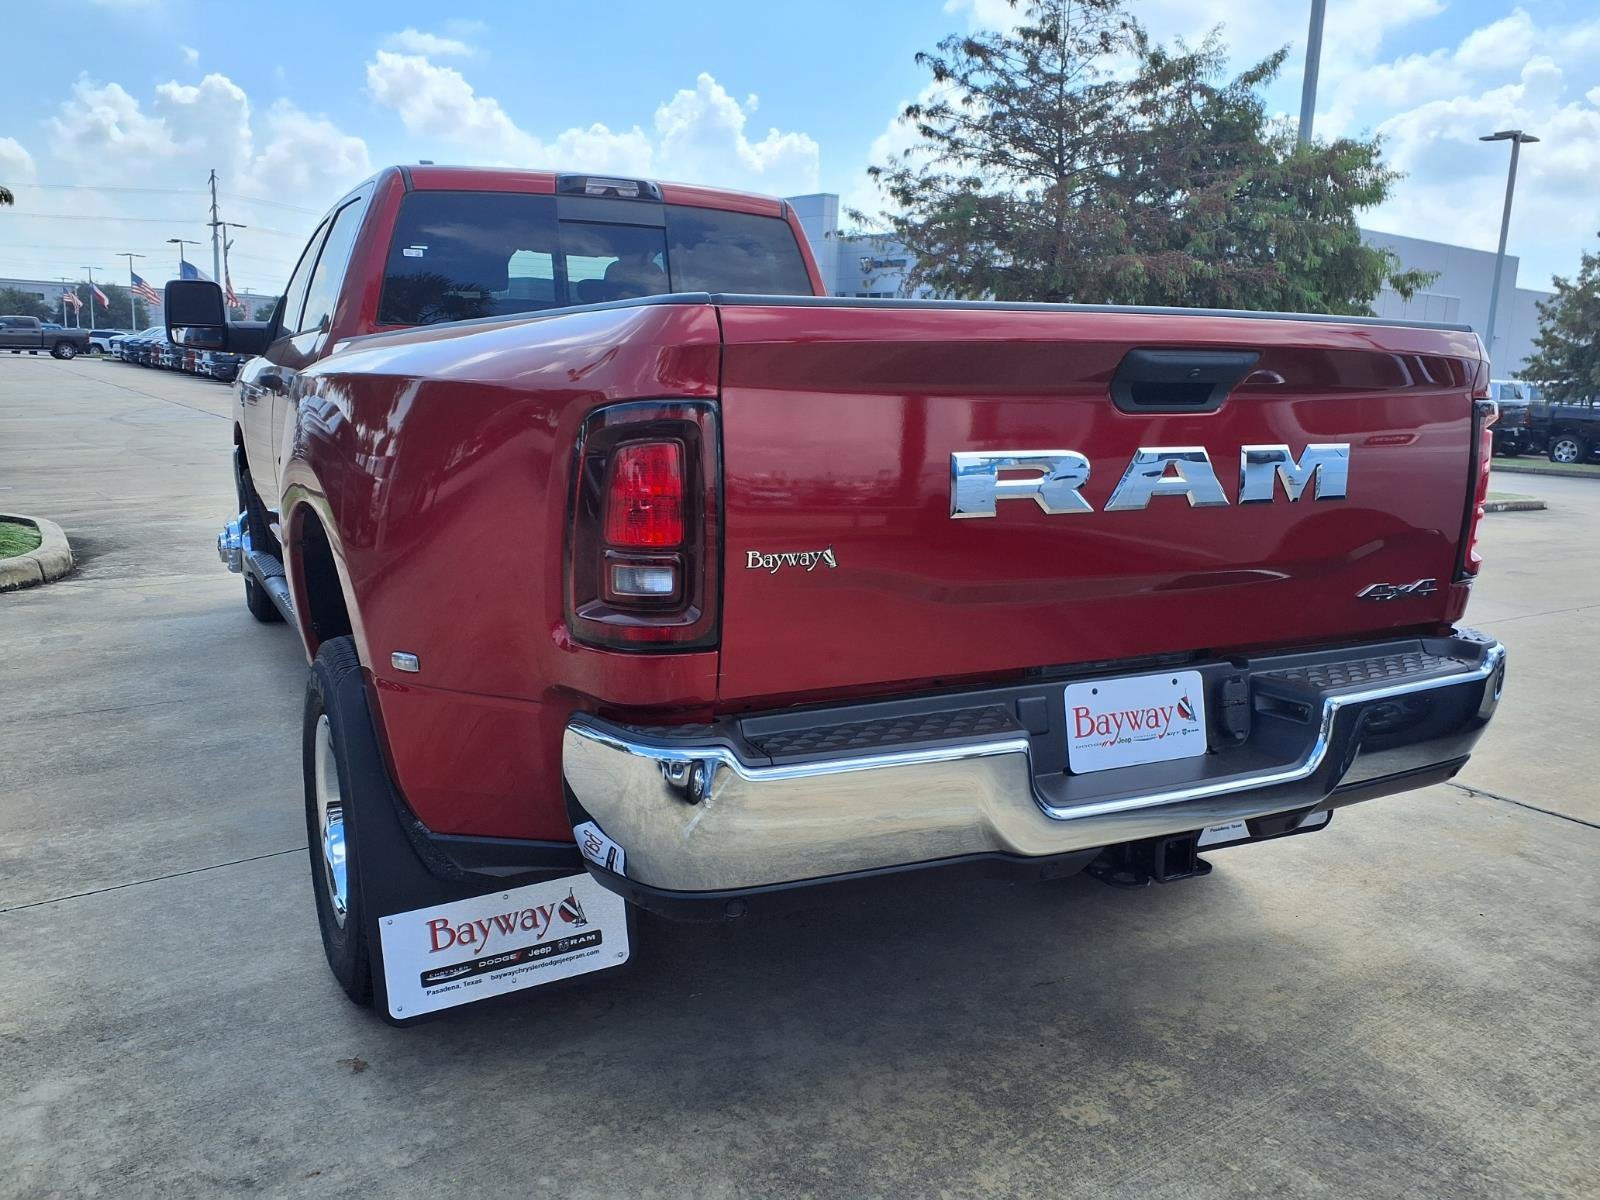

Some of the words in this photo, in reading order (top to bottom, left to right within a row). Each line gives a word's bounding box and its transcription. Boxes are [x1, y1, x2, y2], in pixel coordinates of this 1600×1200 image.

[950, 443, 1351, 519] RAM
[745, 550, 822, 574] Bayway
[1072, 706, 1174, 746] Bayway
[425, 902, 556, 955] Bayway
[478, 953, 517, 968] DODGE
[528, 946, 552, 957] Jeep
[570, 934, 596, 946] RAM
[463, 978, 483, 988] Texas
